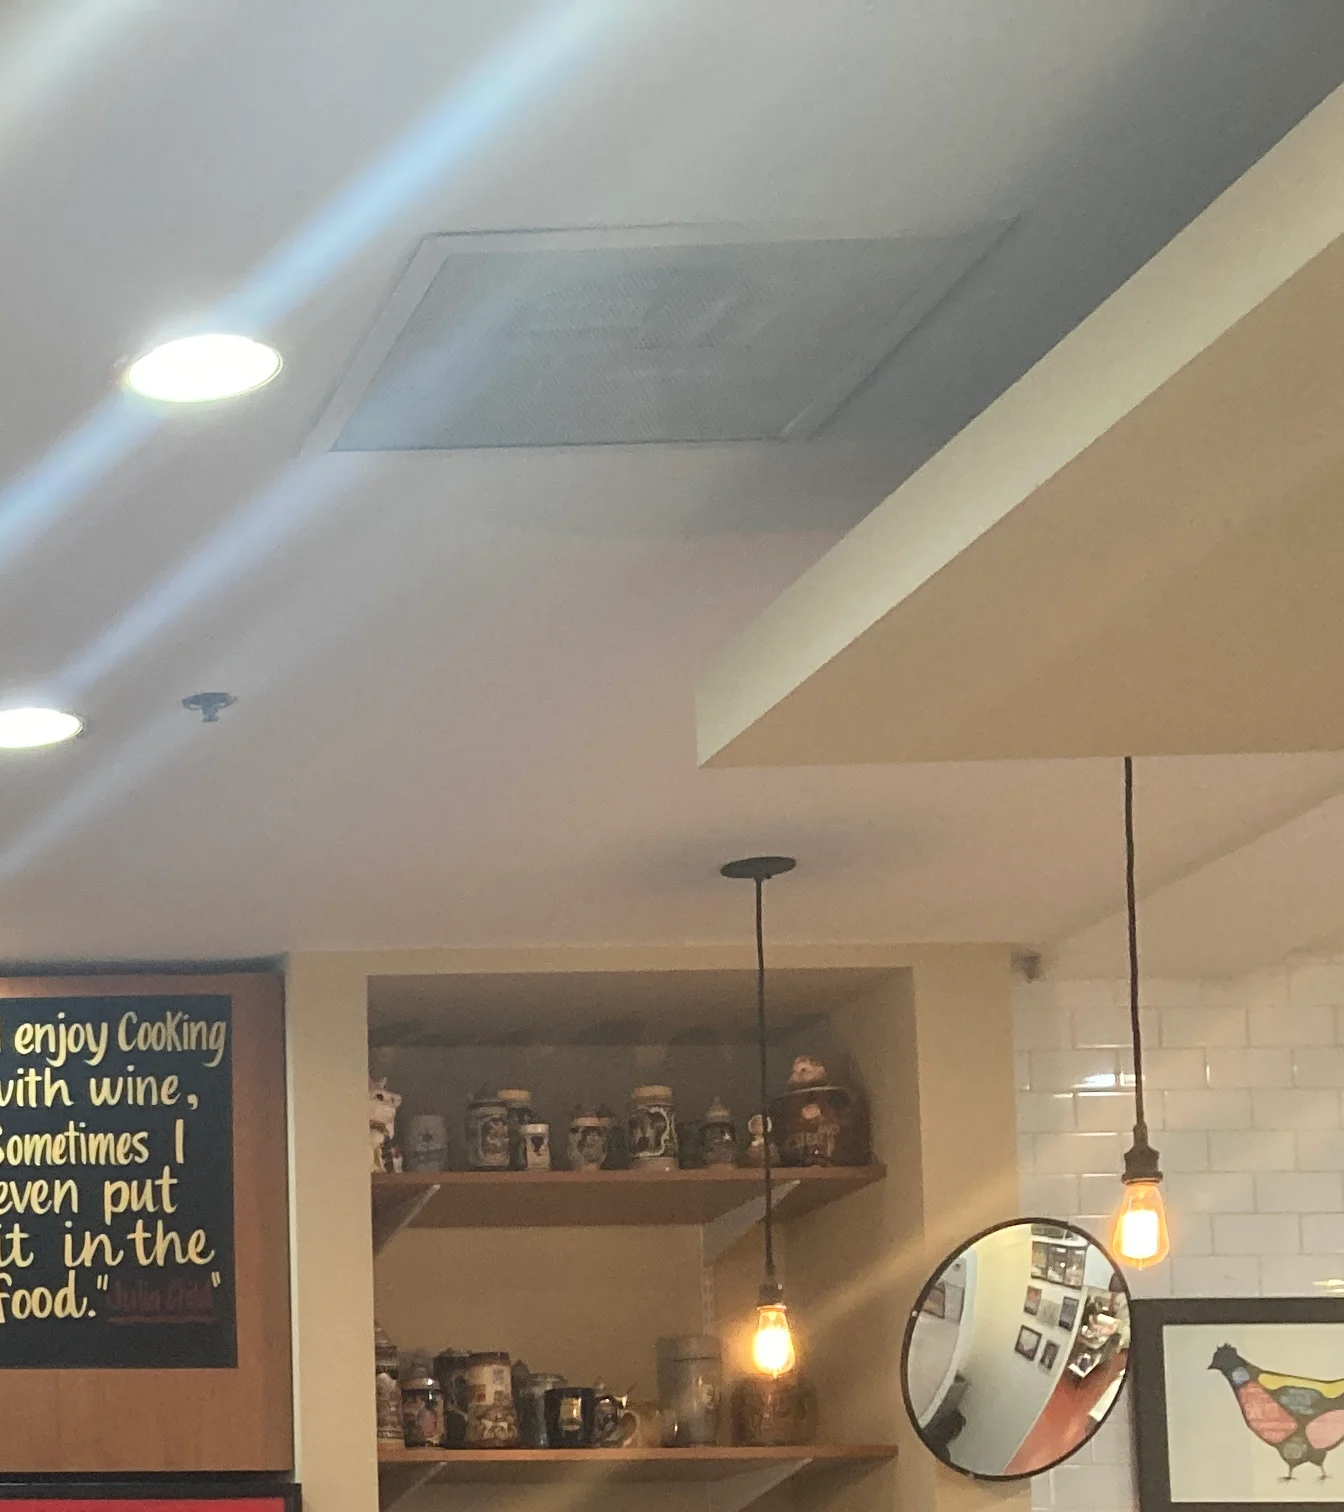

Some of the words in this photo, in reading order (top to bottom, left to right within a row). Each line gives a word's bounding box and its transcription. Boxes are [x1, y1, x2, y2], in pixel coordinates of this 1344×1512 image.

[14, 1012, 109, 1067] enjoy
[89, 1064, 199, 1110] wine,
[175, 1118, 185, 1164] I
[104, 1165, 178, 1226] put
[64, 1220, 124, 1267] in
[127, 1219, 216, 1267] the
